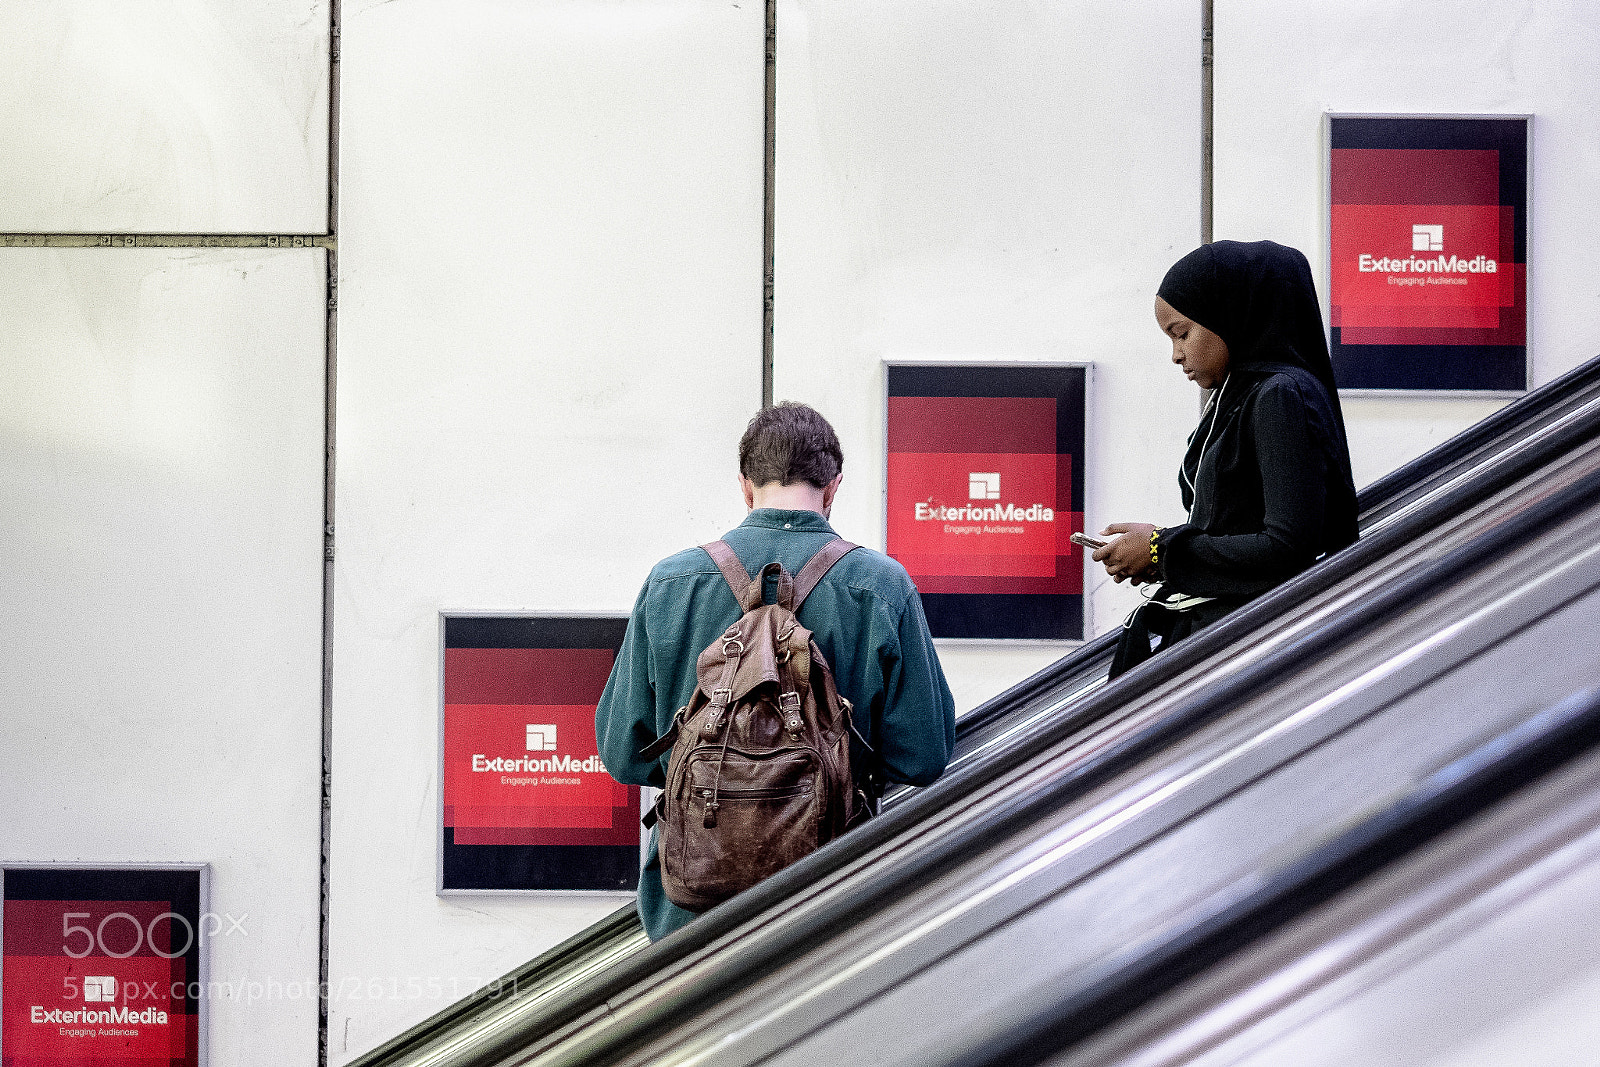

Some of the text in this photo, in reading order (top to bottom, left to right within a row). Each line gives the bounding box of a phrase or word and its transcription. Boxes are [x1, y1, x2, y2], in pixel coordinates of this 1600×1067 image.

[1358, 253, 1497, 273] ExterionMedia
[1387, 275, 1468, 287] Engaging Audiences
[914, 502, 1054, 522] ExterionMedia
[943, 524, 1024, 535] Engaging Audiences
[500, 776, 581, 787] Engaging Audiences
[30, 1005, 168, 1025] ExterionMedia
[59, 1028, 139, 1038] Engaging Audiences
